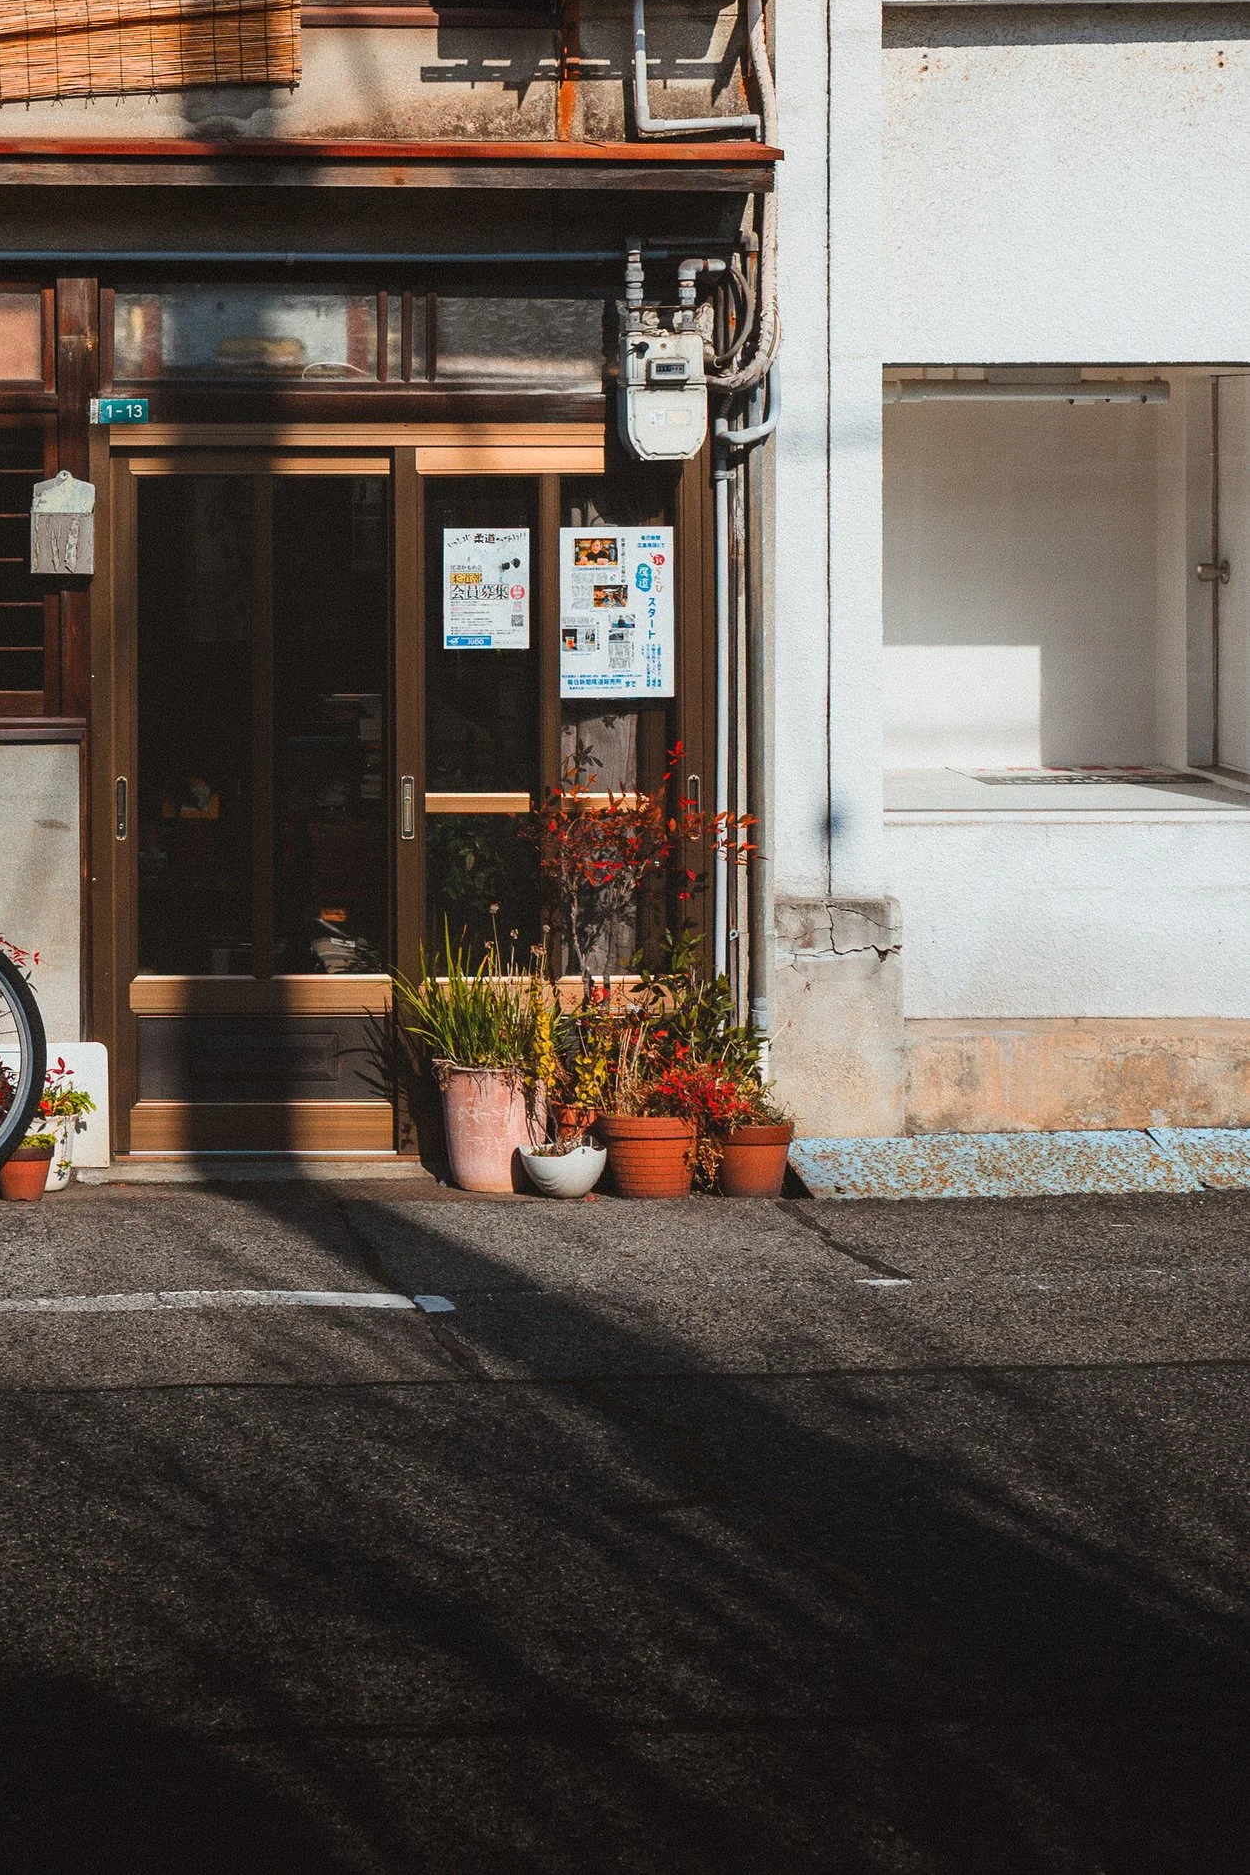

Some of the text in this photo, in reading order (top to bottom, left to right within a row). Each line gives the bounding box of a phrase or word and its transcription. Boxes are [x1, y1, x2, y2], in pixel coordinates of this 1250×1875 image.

[106, 404, 143, 419] 1-13
[647, 597, 656, 640] スタート
